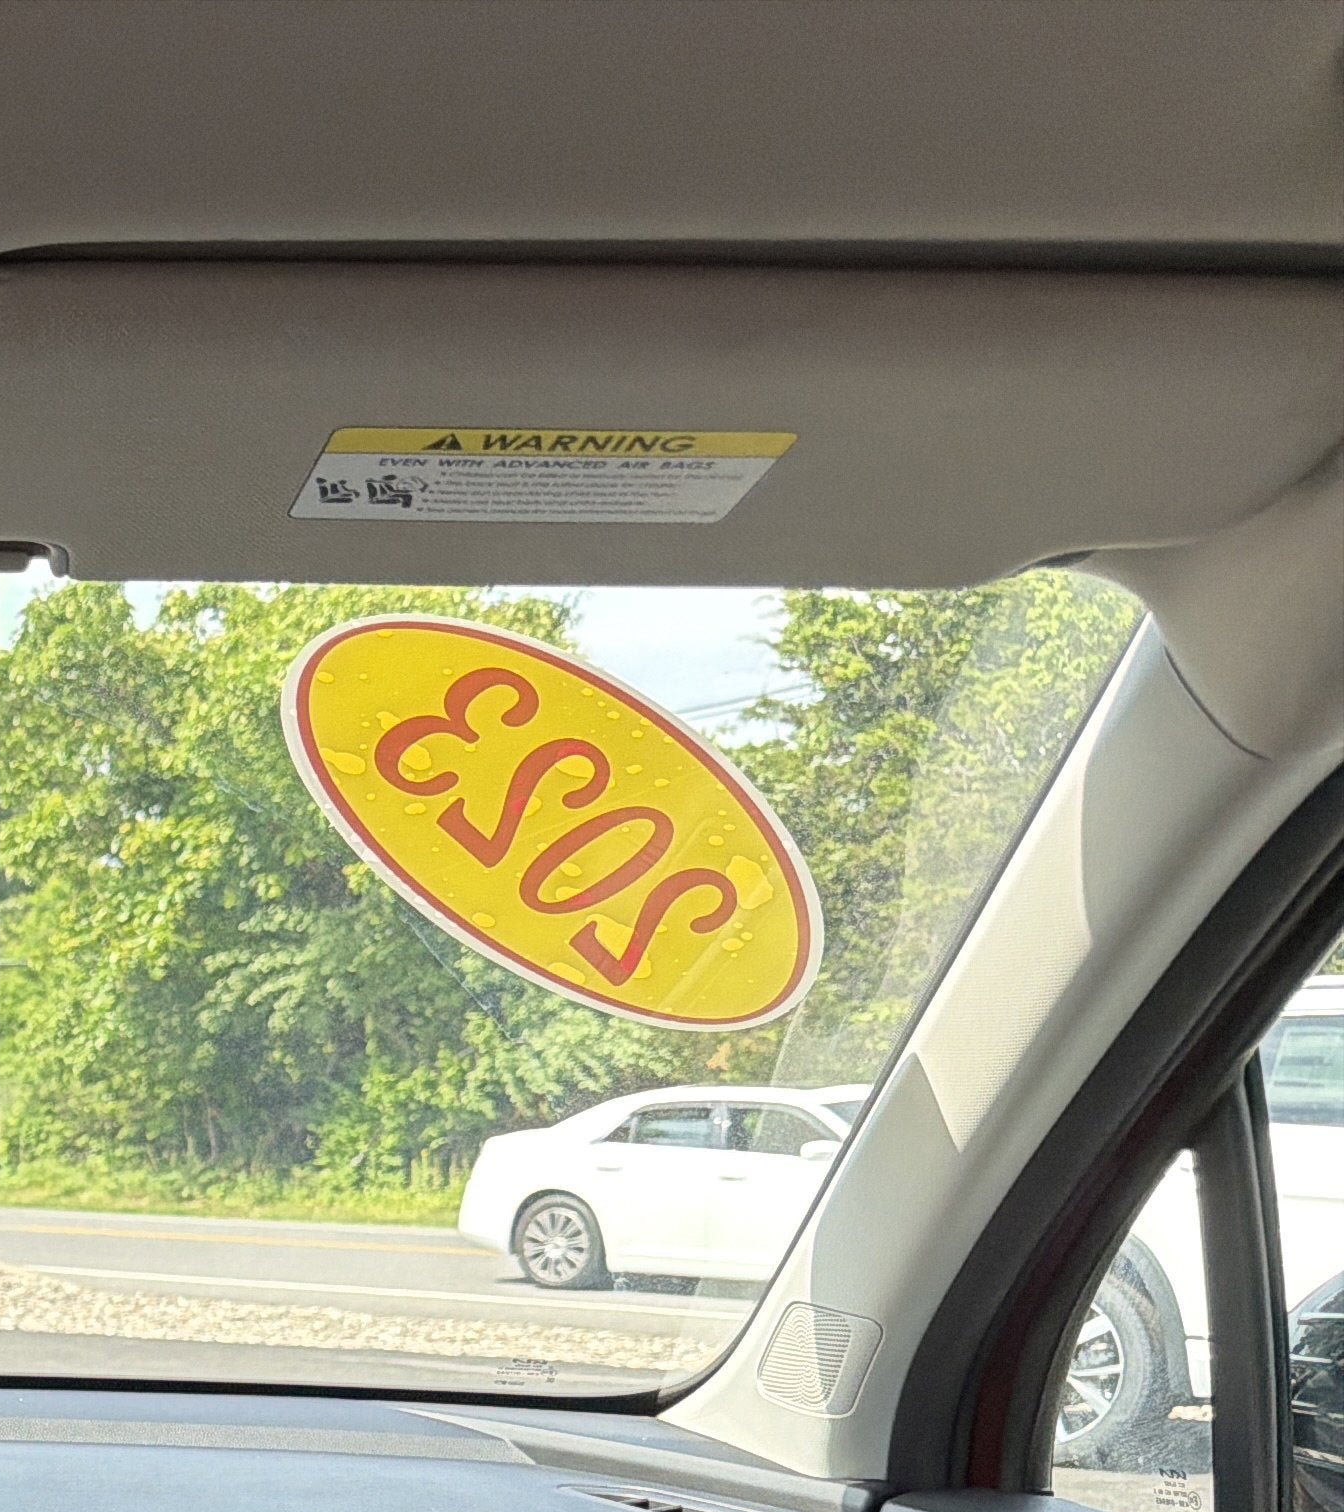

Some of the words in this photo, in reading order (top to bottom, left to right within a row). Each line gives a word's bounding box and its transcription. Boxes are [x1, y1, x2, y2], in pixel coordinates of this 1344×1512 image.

[482, 434, 696, 452] WARNING
[378, 458, 428, 467] EVEN
[438, 459, 484, 467] WITH
[493, 459, 607, 469] ADVANCED
[617, 461, 651, 469] AIR
[659, 461, 715, 470] BAGS
